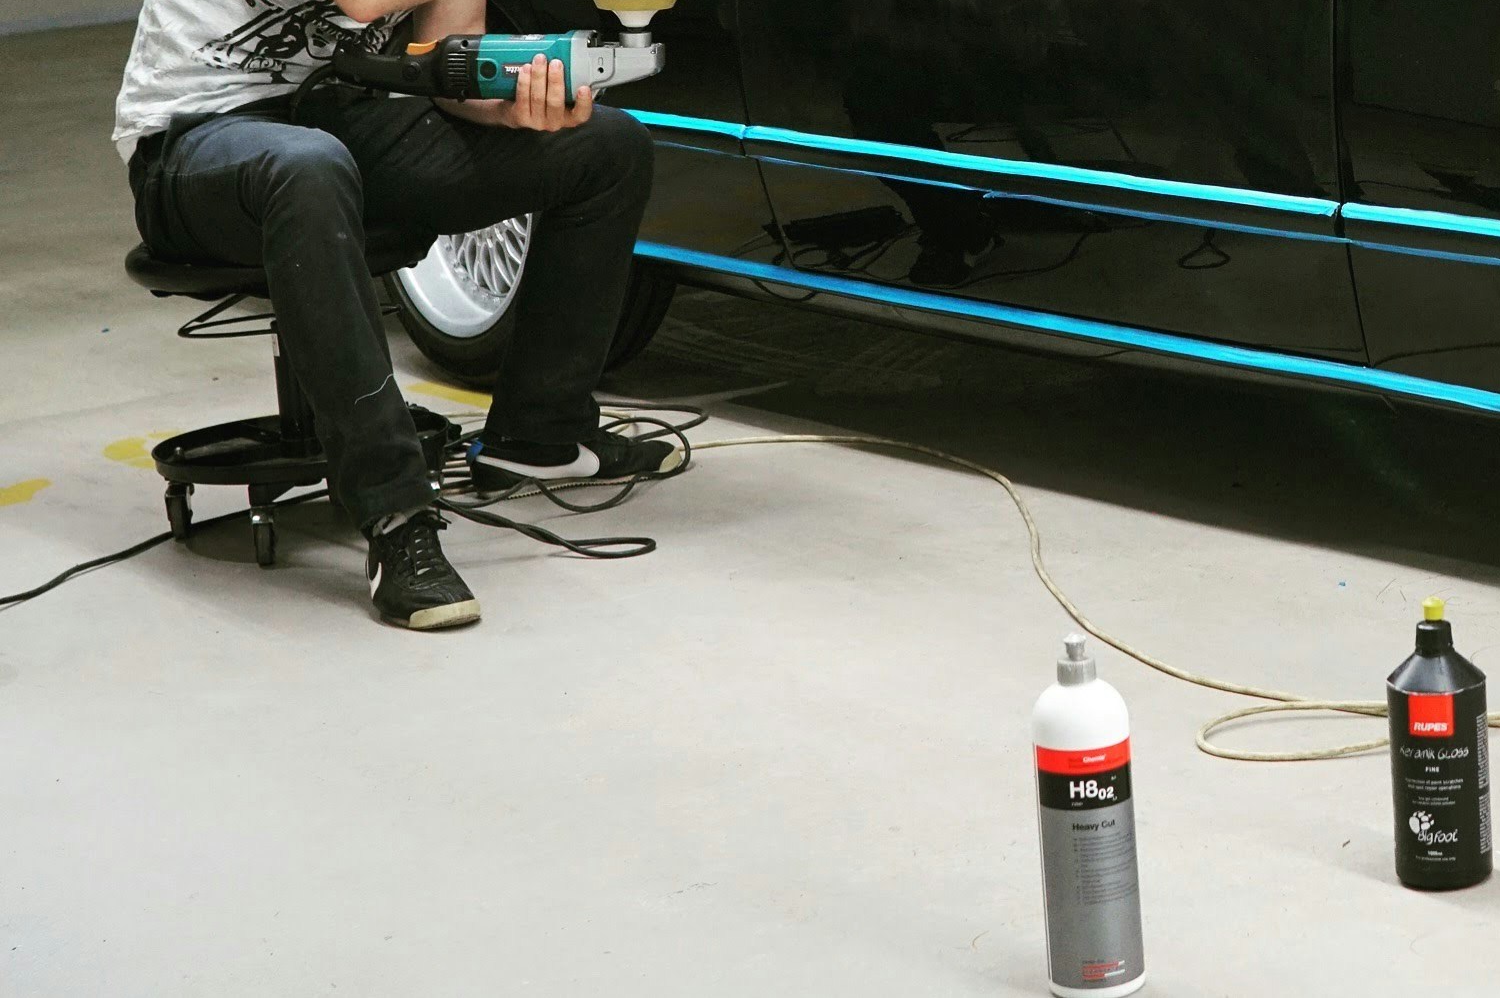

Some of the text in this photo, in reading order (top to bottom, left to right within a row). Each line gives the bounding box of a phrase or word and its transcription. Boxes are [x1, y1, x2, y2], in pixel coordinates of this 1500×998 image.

[1413, 722, 1448, 732] RUPES
[1072, 819, 1116, 831] Heavy Cut
